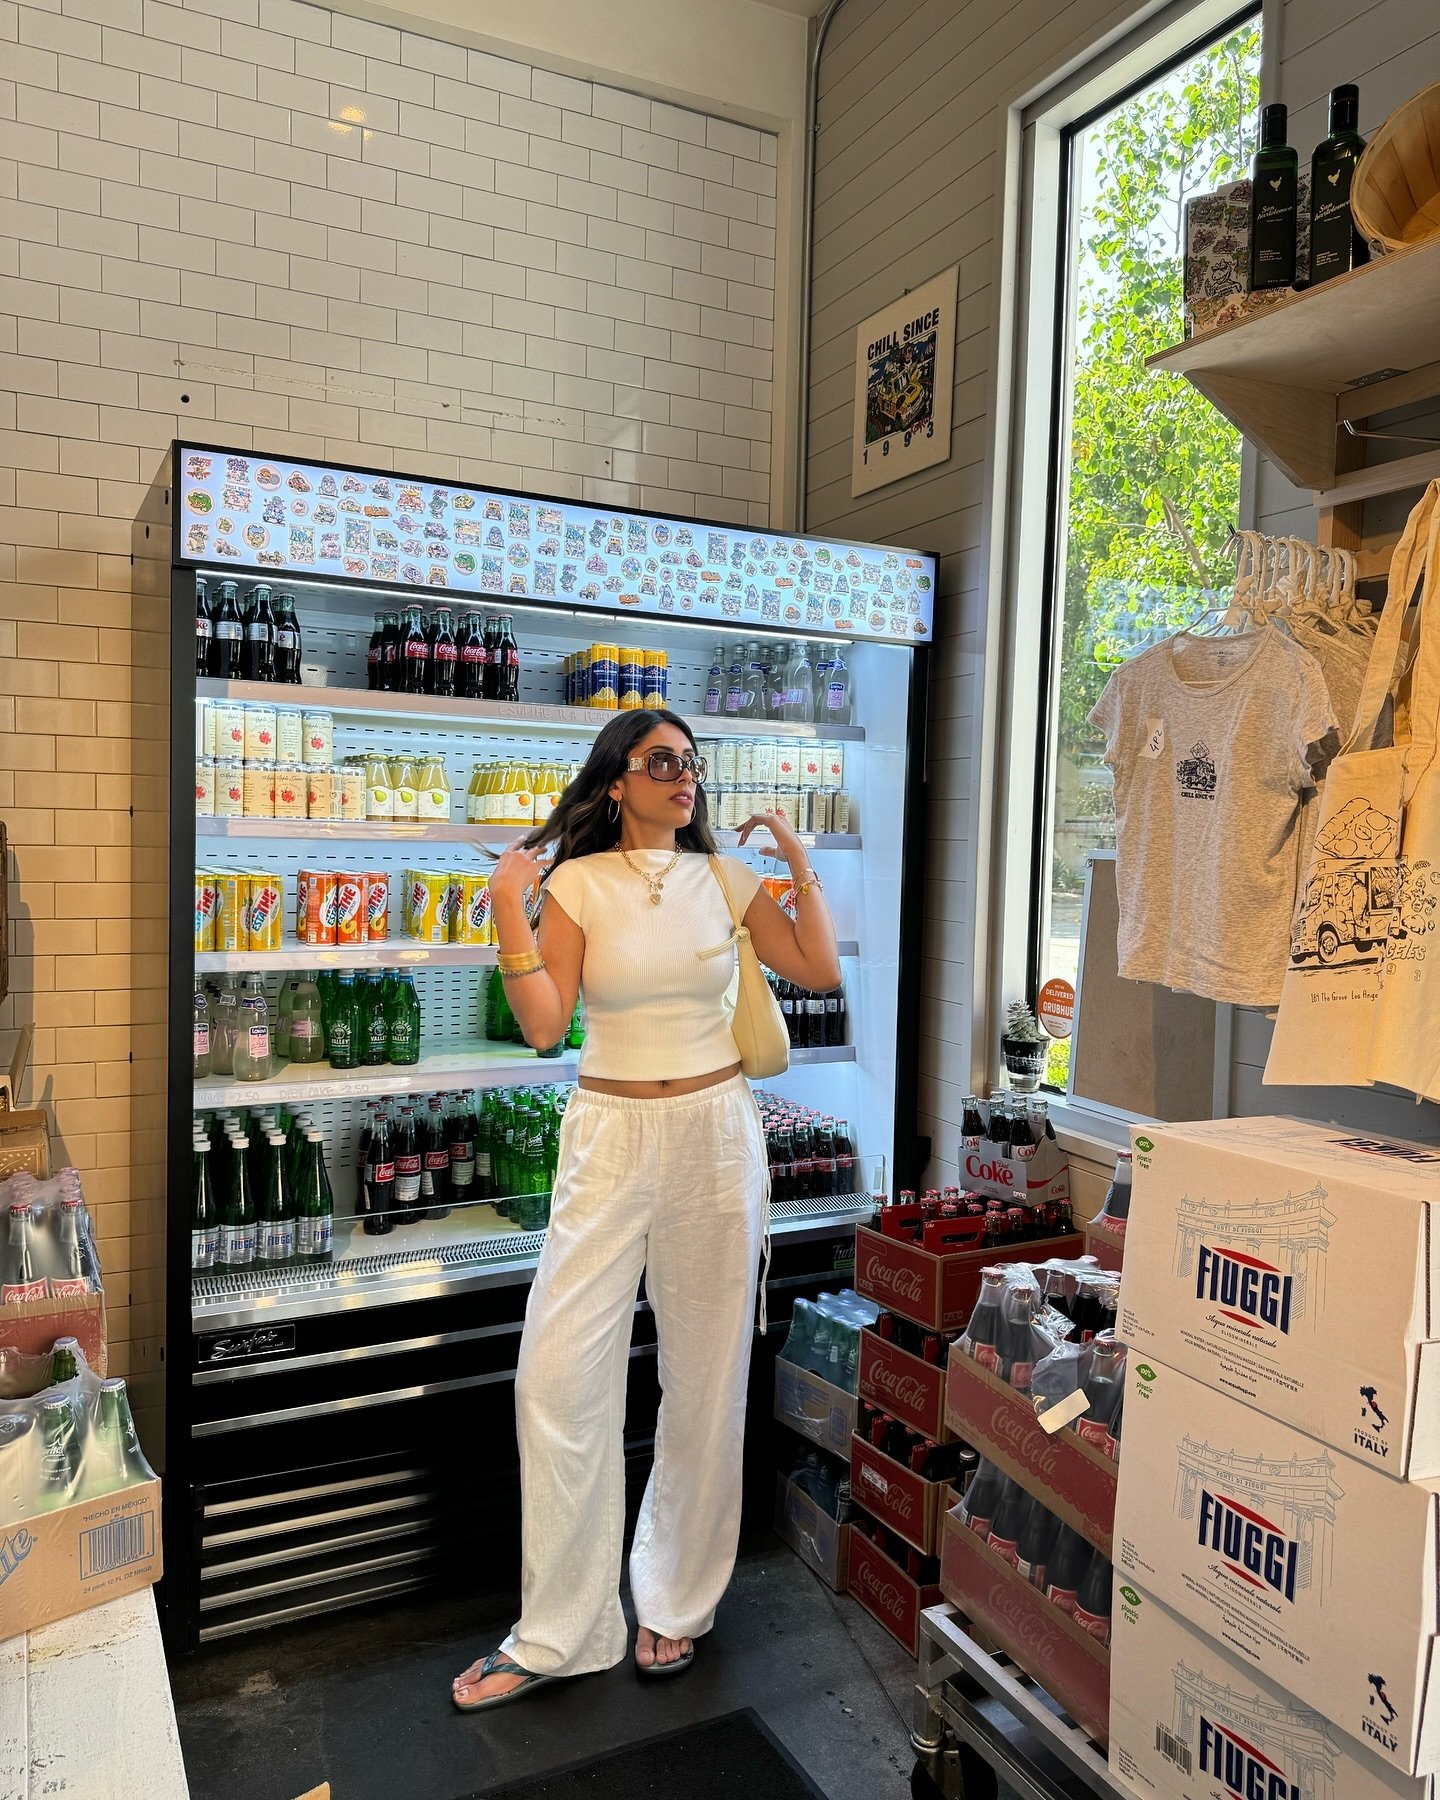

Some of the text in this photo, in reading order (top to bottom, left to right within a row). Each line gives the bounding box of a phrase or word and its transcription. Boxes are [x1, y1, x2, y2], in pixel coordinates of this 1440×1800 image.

[867, 308, 940, 361] CHILL SINCE
[1046, 988, 1074, 1000] DELIVERED
[1321, 992, 1330, 1002] The
[1332, 991, 1348, 1001] Grove
[1352, 990, 1361, 1000] Los
[966, 1155, 1014, 1186] Coke
[1136, 1154, 1152, 1164] plastic
[1139, 1160, 1150, 1170] free
[1051, 1184, 1066, 1195] Coke
[866, 1256, 924, 1303] Coca-Cola
[1196, 1244, 1293, 1336] FIUGGI
[1206, 1314, 1277, 1348] Acqua minerale naturale
[869, 1359, 929, 1412] Coca-Cola
[1136, 1380, 1154, 1394] plastic
[1138, 1389, 1150, 1400] free
[991, 1406, 1062, 1476] Coca-Cola
[1354, 1433, 1388, 1458] ITALY
[110, 1505, 121, 1514] EN
[1198, 1488, 1298, 1604] FIUGGI
[858, 1560, 908, 1621] Coca-Cola
[1208, 1564, 1282, 1614] Acqua minerale naturale
[1121, 1604, 1140, 1620] plastic
[1124, 1612, 1136, 1625] free
[1362, 1720, 1398, 1752] ITALY
[1199, 1715, 1300, 1800] FIUGG
